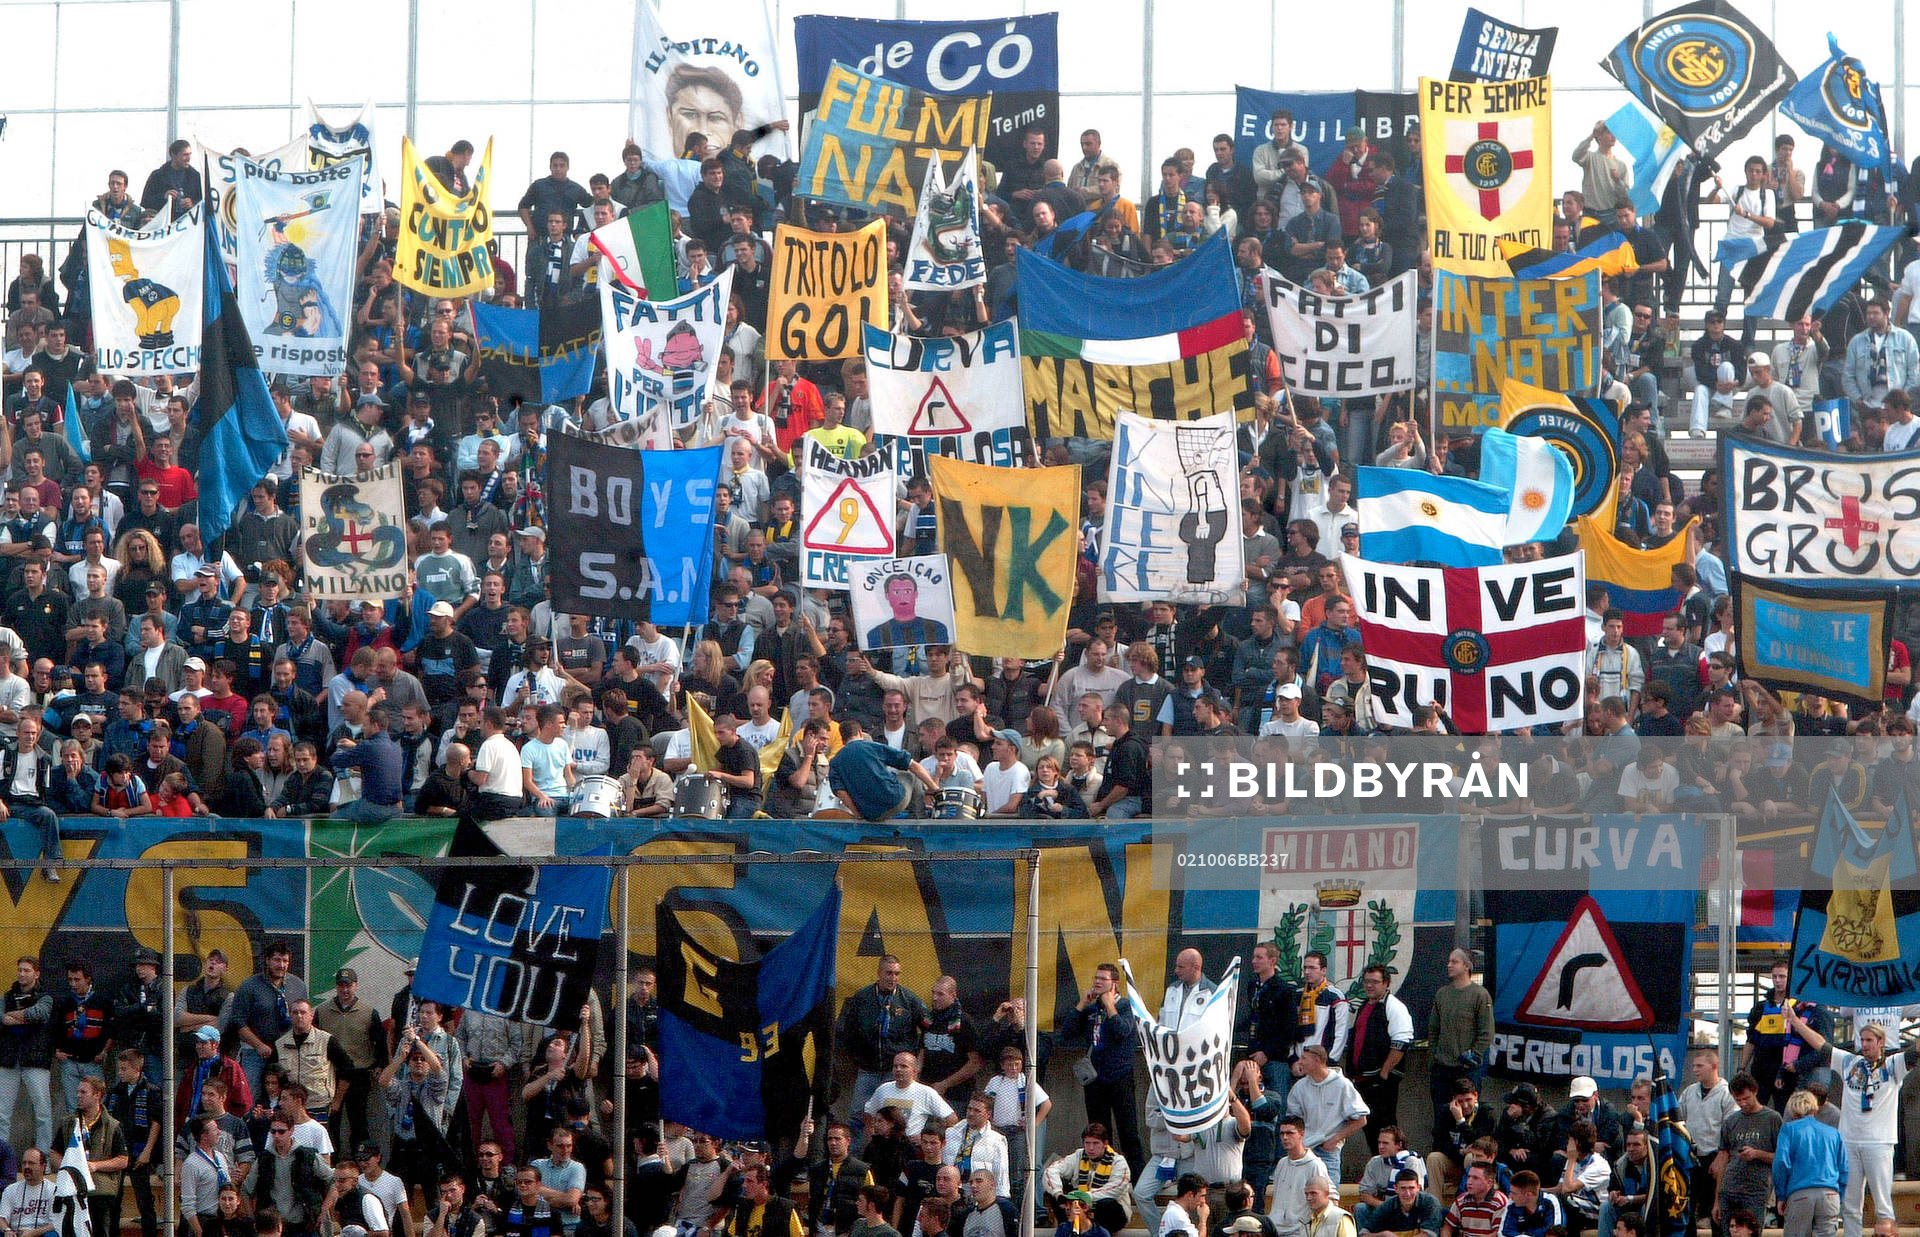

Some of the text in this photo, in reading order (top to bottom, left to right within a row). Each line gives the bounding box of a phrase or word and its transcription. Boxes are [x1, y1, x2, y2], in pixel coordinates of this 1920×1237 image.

[1479, 21, 1541, 56] SENZA
[1646, 24, 1684, 50] INTER
[645, 50, 667, 74] IL
[857, 40, 913, 77] de
[1471, 47, 1532, 80] INTER
[1430, 75, 1549, 114] PER SEMPRE
[1710, 80, 1738, 105] 1908
[992, 102, 1046, 137] Terme
[1435, 229, 1454, 258] AL
[1459, 232, 1487, 262] TUO
[785, 234, 878, 299] TRITOLO
[909, 256, 986, 286] FEDE
[612, 284, 722, 334] FATTI
[1269, 277, 1404, 317] FATTI
[1442, 277, 1587, 336] INTER
[864, 320, 1016, 372] CURVA
[1315, 321, 1361, 353] DI
[633, 368, 664, 397] PER
[1022, 337, 1256, 440] MARCHE
[1442, 399, 1502, 428] MO
[810, 440, 894, 479] HERNAN
[569, 464, 713, 528] BOYS
[310, 516, 317, 528] D
[837, 497, 858, 544] 9
[307, 573, 407, 594] MILANO
[1831, 620, 1856, 642] TE
[1272, 828, 1411, 871] MILANO
[1499, 823, 1683, 871] CURVA
[450, 882, 585, 961] LOVE
[449, 945, 567, 1026] YOU
[1795, 943, 1920, 997] SVARION
[1490, 1034, 1677, 1080] PERICOLOSA
